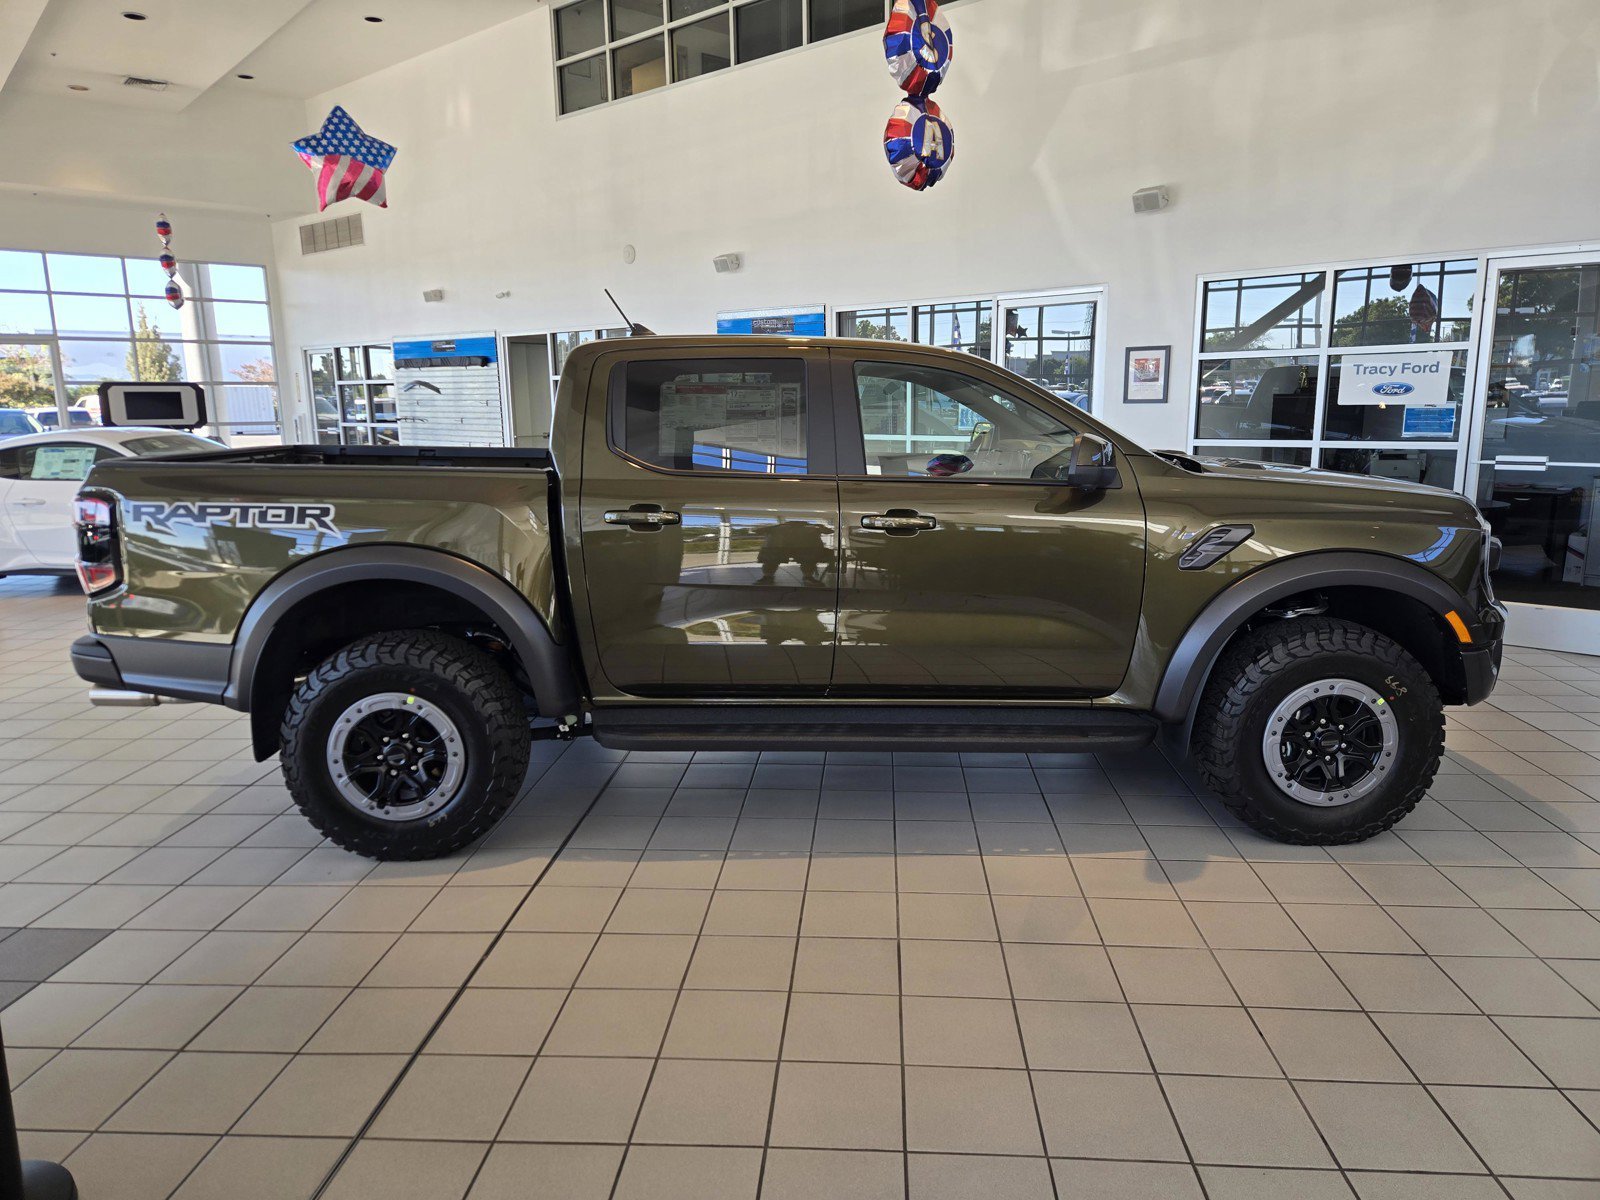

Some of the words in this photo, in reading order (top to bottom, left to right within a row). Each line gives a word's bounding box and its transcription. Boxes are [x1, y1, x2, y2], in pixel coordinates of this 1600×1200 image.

[921, 119, 945, 160] A
[1353, 363, 1398, 376] Tracy
[1401, 361, 1440, 374] Ford
[131, 501, 344, 540] RAPTOR
